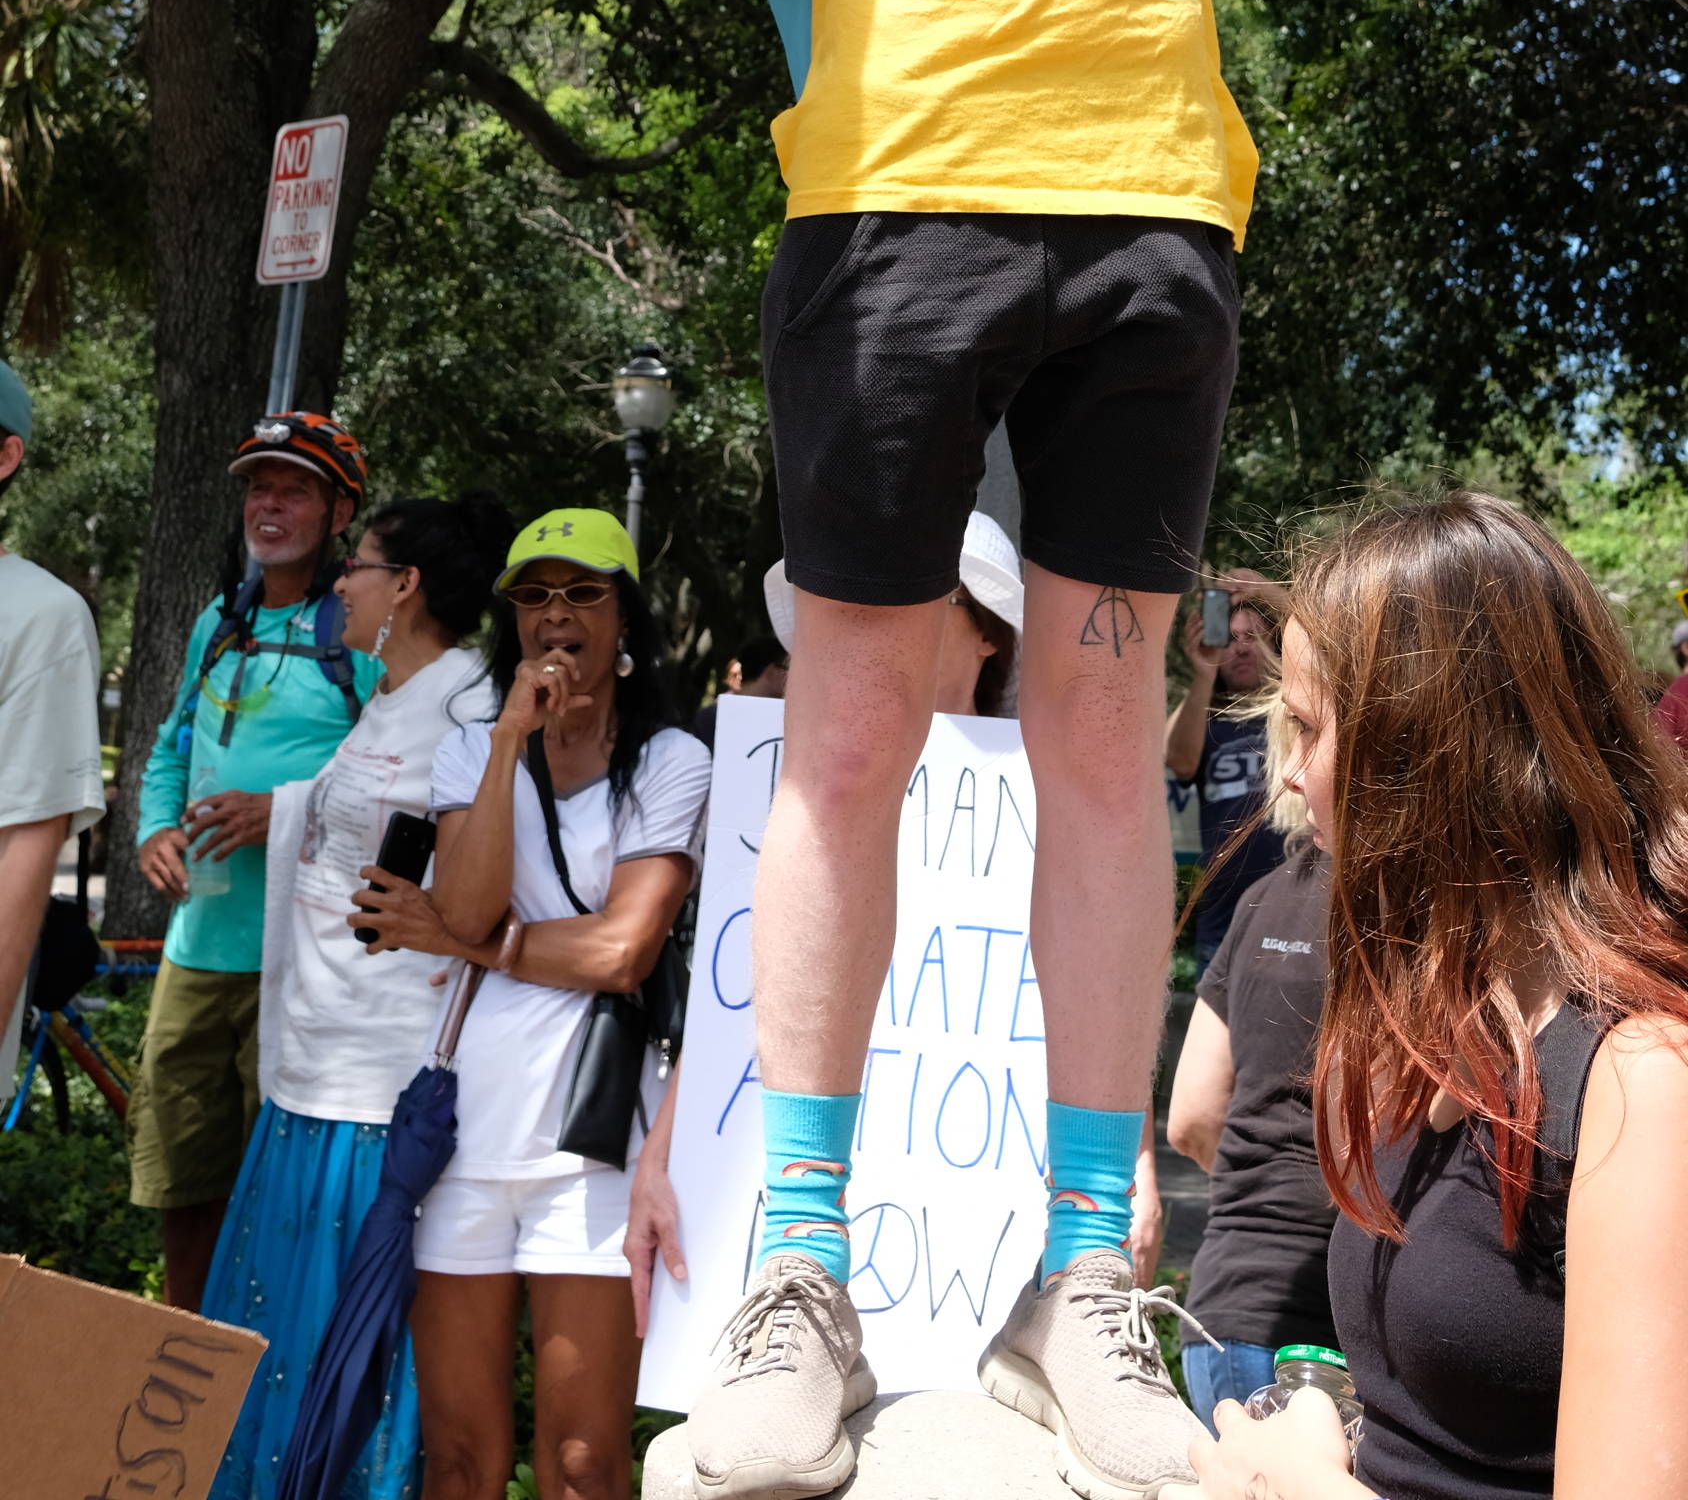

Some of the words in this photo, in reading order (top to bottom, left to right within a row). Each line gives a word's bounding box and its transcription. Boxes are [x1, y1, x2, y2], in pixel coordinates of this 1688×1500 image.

[278, 135, 312, 175] NO
[272, 179, 334, 213] PARKING
[294, 212, 308, 231] TO
[272, 232, 322, 255] CORNER
[717, 1048, 1048, 1177] ATION
